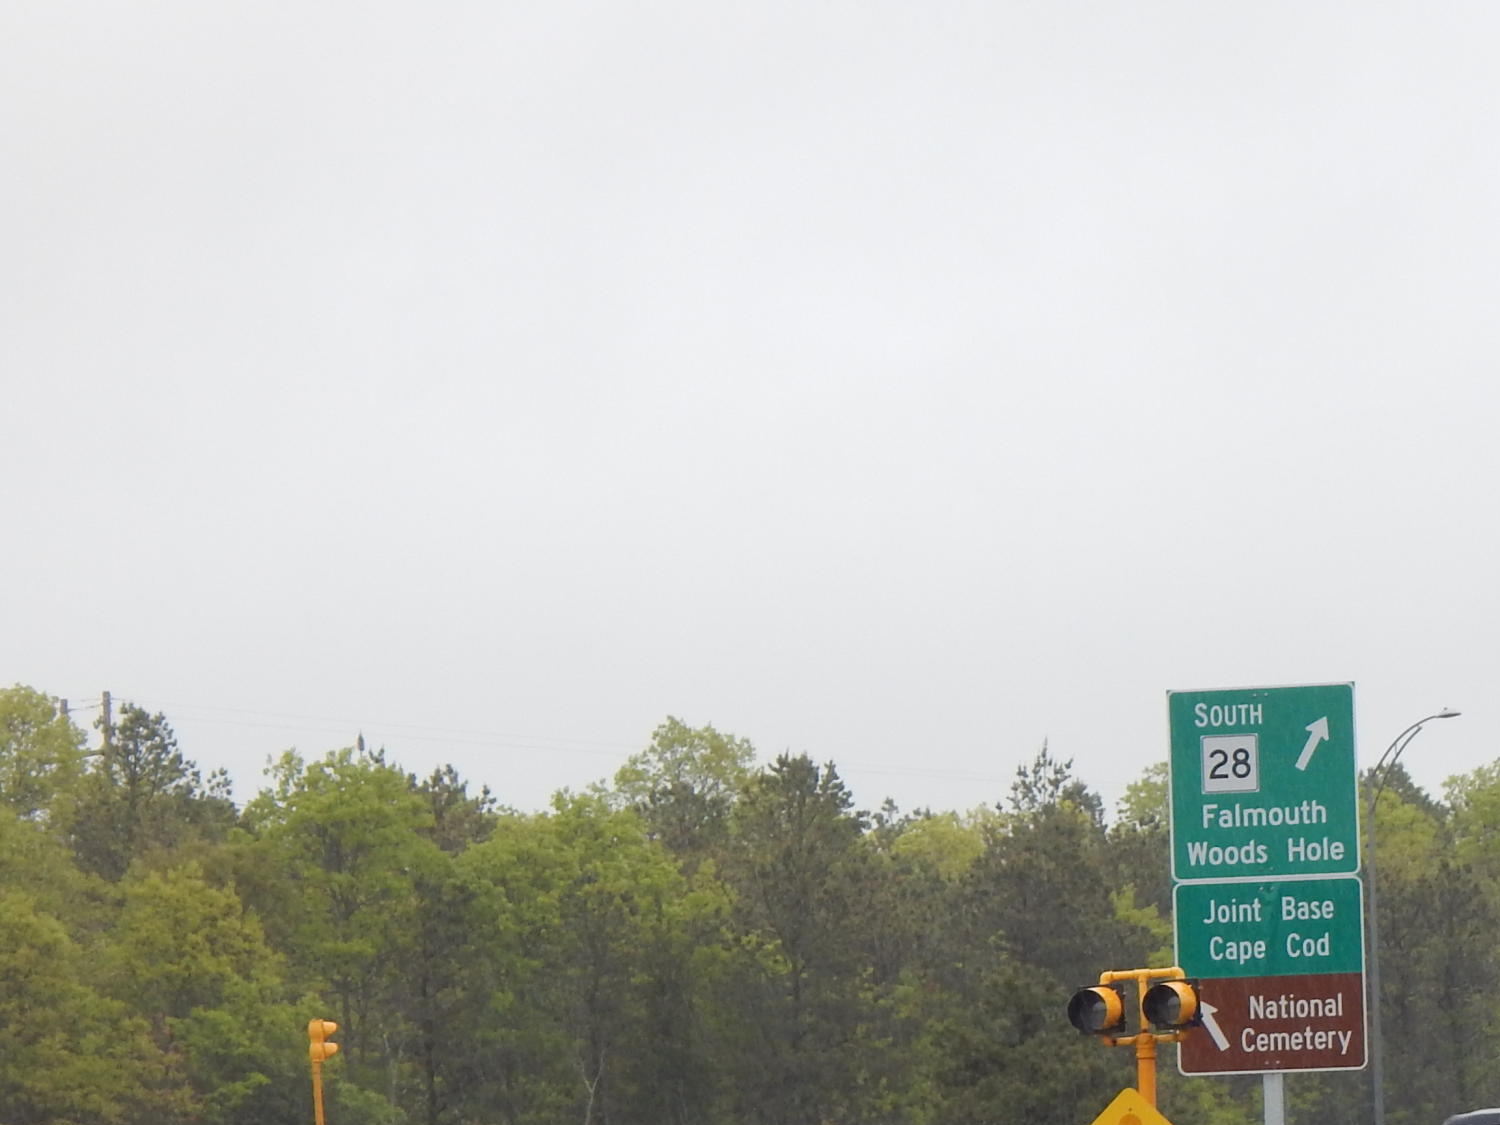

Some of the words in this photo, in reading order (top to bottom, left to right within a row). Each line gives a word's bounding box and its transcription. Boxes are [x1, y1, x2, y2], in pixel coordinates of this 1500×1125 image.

[1194, 703, 1263, 728] SOUTH
[1209, 748, 1252, 780] 28
[1202, 800, 1327, 829] Falmouth
[1187, 840, 1268, 866] Woods
[1287, 837, 1345, 862] Hole
[1203, 898, 1262, 924] Joint
[1281, 896, 1335, 921] Base
[1209, 936, 1266, 965] Cape
[1286, 932, 1330, 958] Cod
[1250, 992, 1343, 1020] National
[1241, 1026, 1352, 1055] Cemetery
